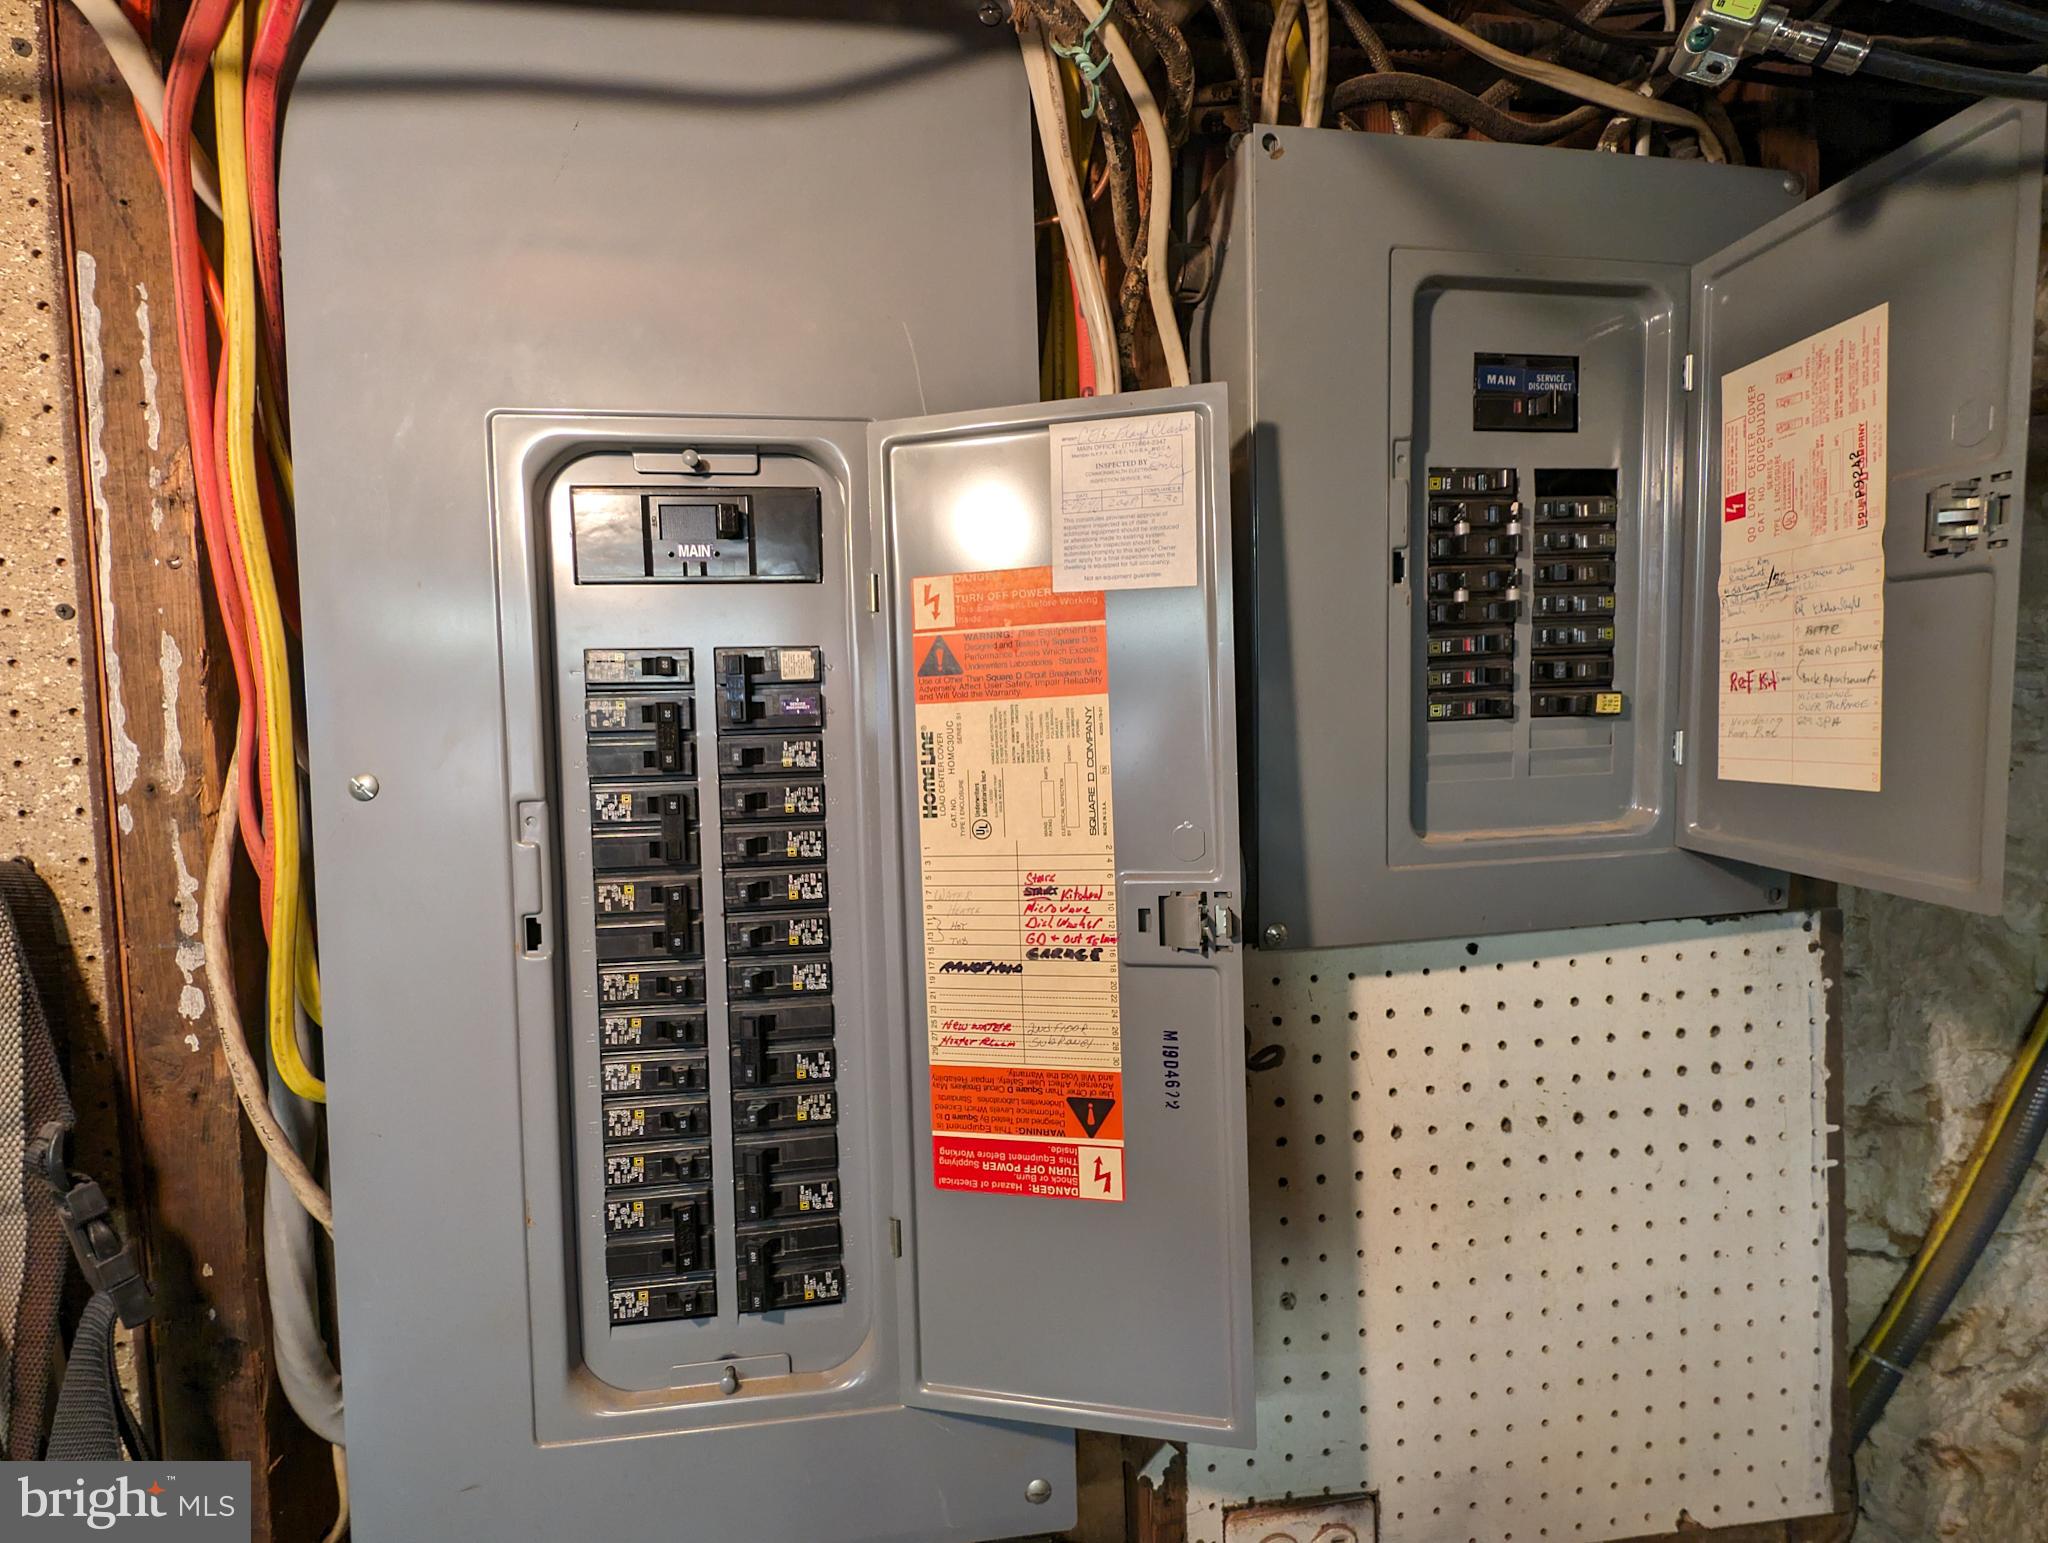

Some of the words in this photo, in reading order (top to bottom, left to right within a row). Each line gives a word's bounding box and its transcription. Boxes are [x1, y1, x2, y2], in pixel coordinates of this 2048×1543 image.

[1487, 375, 1516, 386] MAIN
[1537, 374, 1564, 382] SERVICE
[1528, 382, 1572, 391] DISCONNECT
[1748, 385, 1756, 424] COVER
[1748, 432, 1756, 478] CENTER
[1096, 460, 1136, 469] INSPECTED
[1748, 487, 1756, 517] LOAD
[678, 544, 711, 558] MAIN
[956, 593, 983, 603] TURN
[988, 591, 1008, 601] OFF
[1012, 588, 1051, 599] POWER
[963, 632, 1013, 641] WARNING:
[1038, 628, 1086, 638] Equipment
[1036, 678, 1060, 687] Impair
[1064, 677, 1102, 685] Reliability
[1085, 706, 1094, 767] COMPANY
[946, 720, 955, 774] HOMC30UC
[1088, 772, 1094, 781] D
[1088, 787, 1096, 835] SQUARE
[1108, 903, 1114, 911] 10
[1110, 949, 1116, 957] 16
[1110, 964, 1116, 972] 18
[1111, 981, 1117, 990] 20
[1111, 994, 1117, 1003] 22
[1112, 1010, 1118, 1018] 24
[1112, 1026, 1118, 1036] 26
[1112, 1042, 1119, 1051] 28
[932, 1074, 968, 1083] Reliability
[1007, 1070, 1043, 1079] Warranty.
[970, 1075, 994, 1084] Impair
[1026, 1079, 1045, 1087] User
[1048, 1080, 1071, 1088] Affect
[933, 1082, 948, 1090] May
[951, 1083, 980, 1092] Breakers
[983, 1085, 1005, 1093] Circuit
[1074, 1080, 1114, 1090] Adversely
[1016, 1086, 1043, 1095] Square
[1045, 1088, 1064, 1096] Than
[1099, 1090, 1114, 1098] Use
[935, 1103, 962, 1112] Exceed
[965, 1106, 988, 1114] Which
[991, 1107, 1014, 1115] Levels
[953, 1113, 978, 1121] Square
[1016, 1108, 1065, 1117] Performance
[980, 1114, 989, 1122] By
[991, 1116, 1013, 1124] Tested
[1031, 1118, 1065, 1127] Designed
[946, 1123, 991, 1133] Equipment
[994, 1126, 1011, 1134] This
[1016, 1128, 1065, 1136] WARNING:
[939, 1147, 974, 1157] Working
[1048, 1146, 1077, 1155] Inside.
[977, 1151, 1005, 1160] Before
[1008, 1152, 1055, 1164] Equipment
[939, 1156, 979, 1168] Supplying
[1059, 1157, 1077, 1166] This
[982, 1162, 1020, 1172] POWER
[1024, 1165, 1045, 1174] OFF
[1049, 1167, 1078, 1176] TURN
[939, 1177, 978, 1188] Electrical
[1013, 1174, 1036, 1182] Burn.
[1052, 1176, 1078, 1185] Shock
[992, 1181, 1022, 1190] Hazard
[1028, 1184, 1079, 1196] DANGER:
